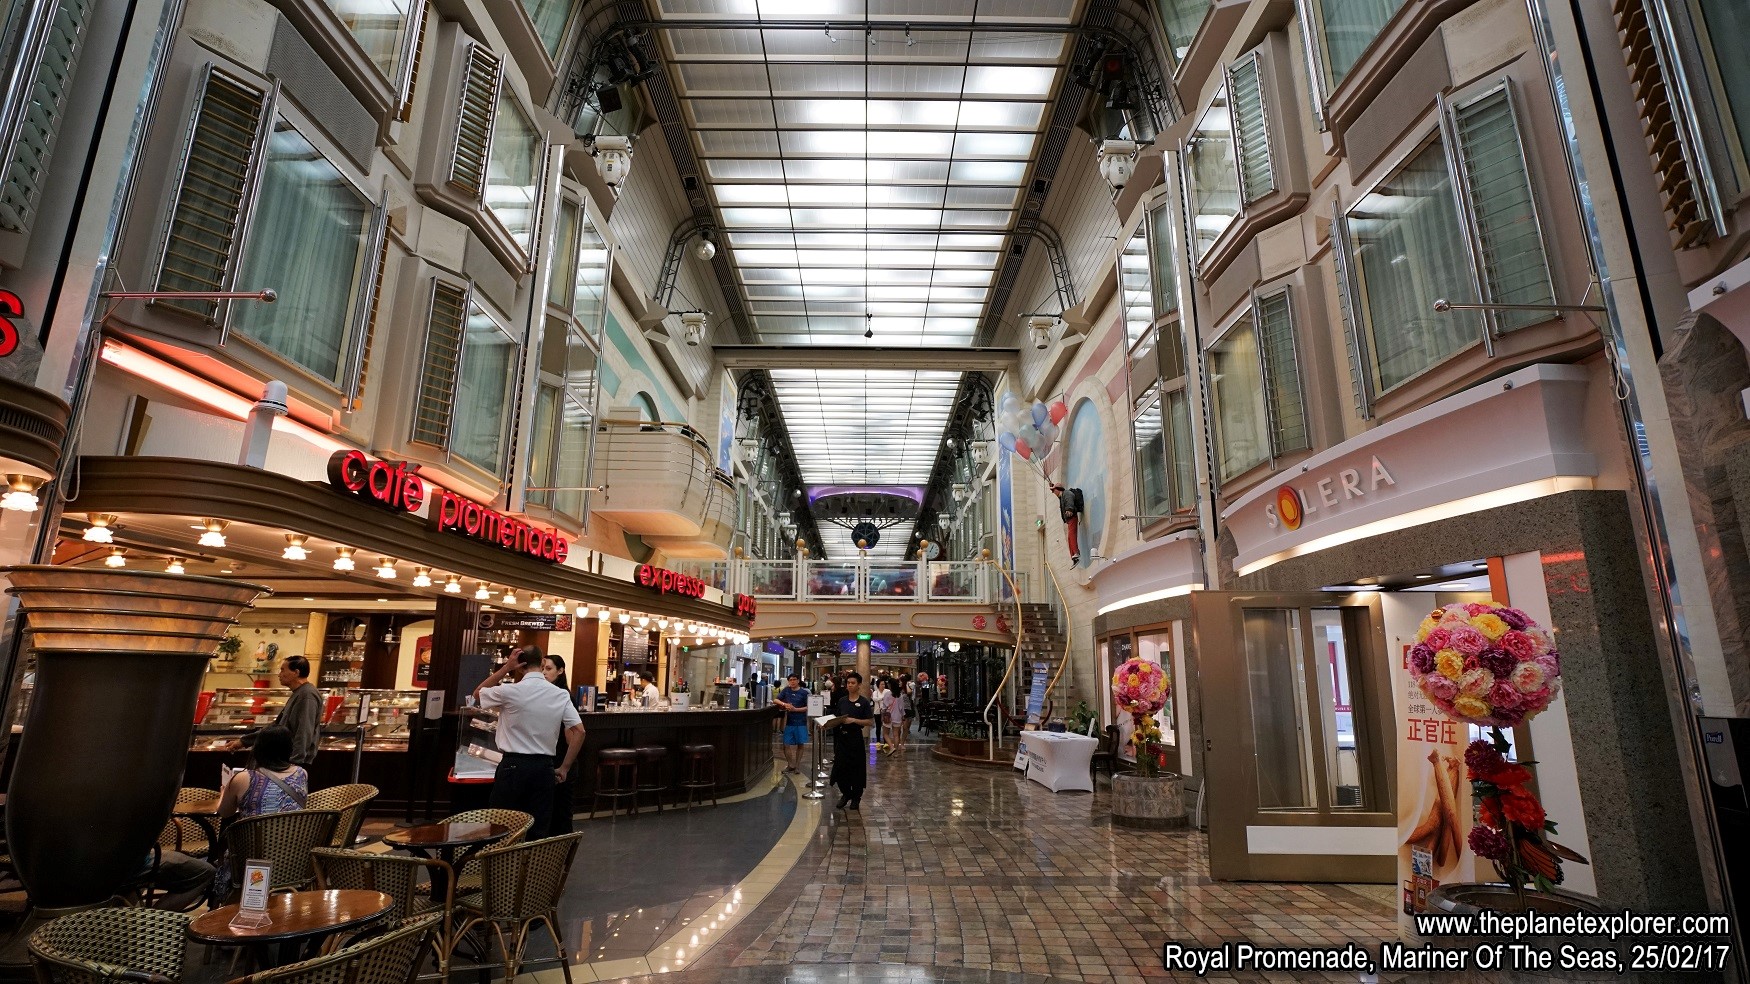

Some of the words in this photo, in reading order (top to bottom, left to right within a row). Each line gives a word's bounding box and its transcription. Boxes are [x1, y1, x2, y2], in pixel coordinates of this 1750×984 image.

[1265, 455, 1395, 531] SOLERA
[434, 489, 569, 564] promenade
[636, 563, 706, 600] expresso
[1406, 717, 1458, 745] 正官庄
